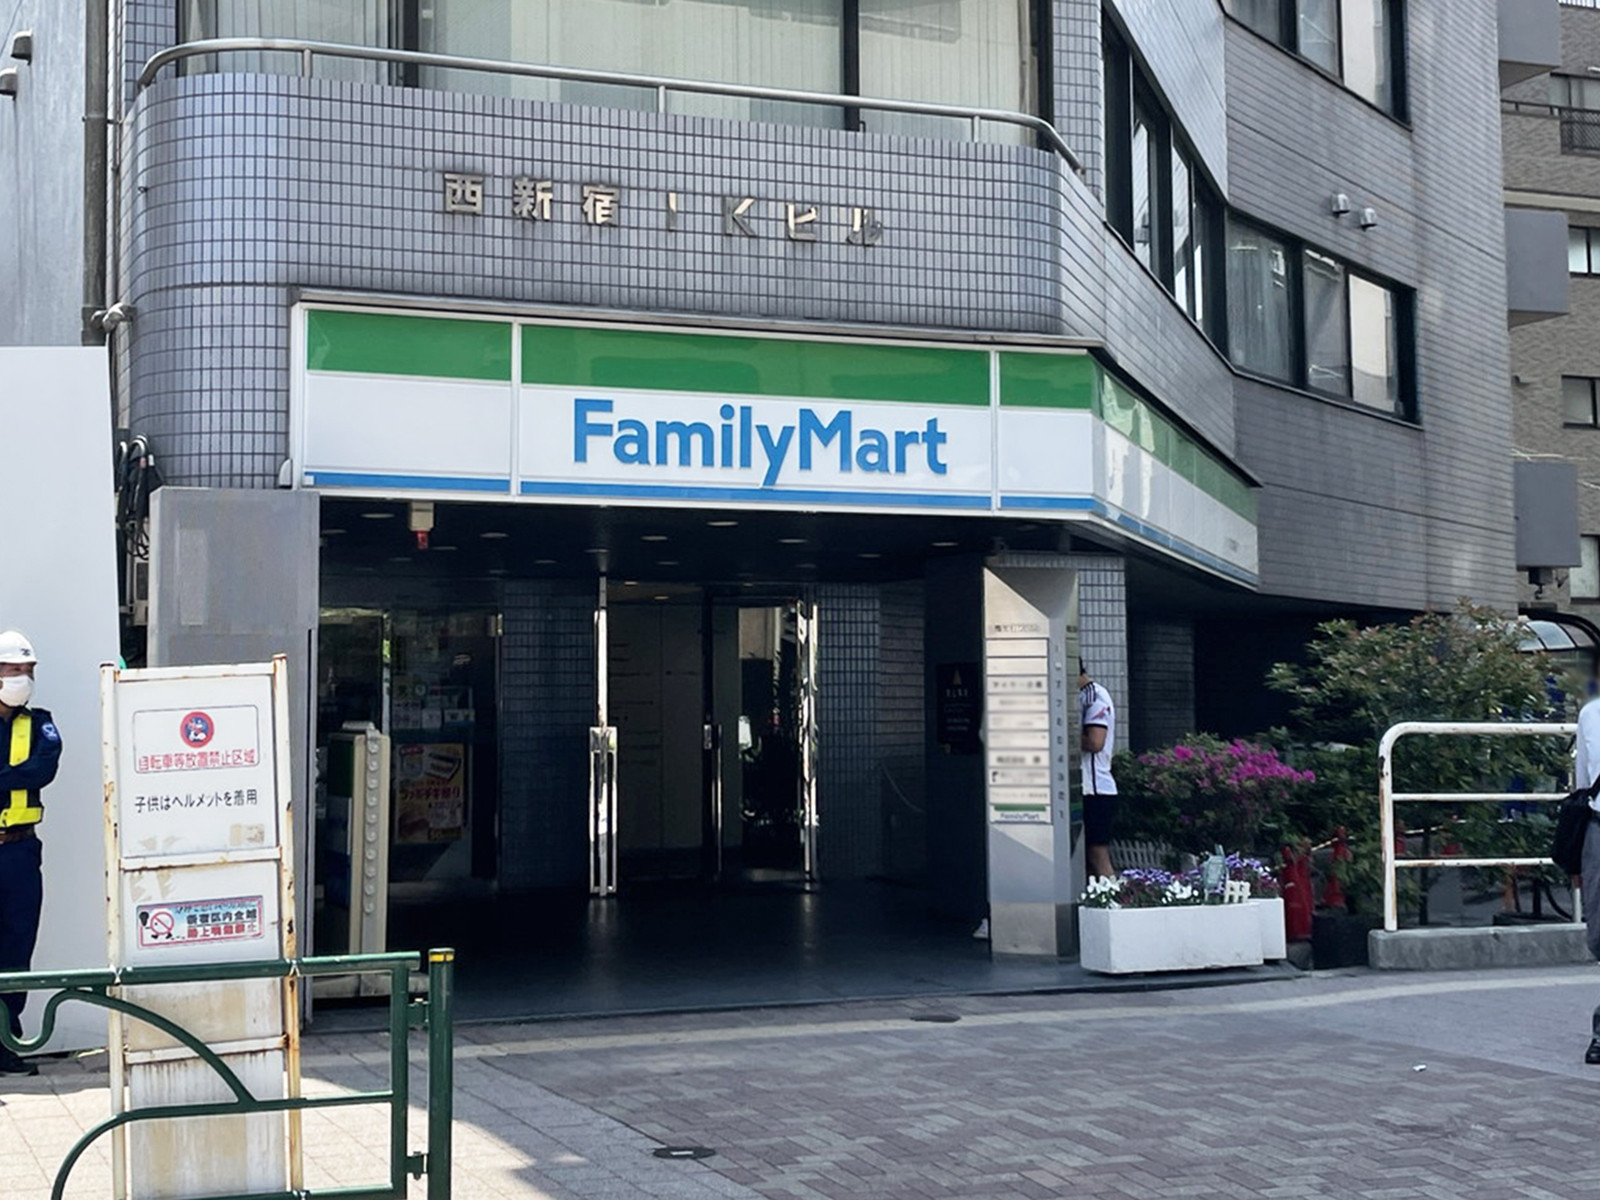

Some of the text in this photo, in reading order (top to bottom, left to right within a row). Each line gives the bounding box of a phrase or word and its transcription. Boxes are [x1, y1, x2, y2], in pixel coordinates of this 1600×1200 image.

[573, 397, 948, 489] FamilyMart
[138, 749, 256, 772] 自転車等放置禁止区域
[134, 788, 258, 814] 子供はヘルメットを着用
